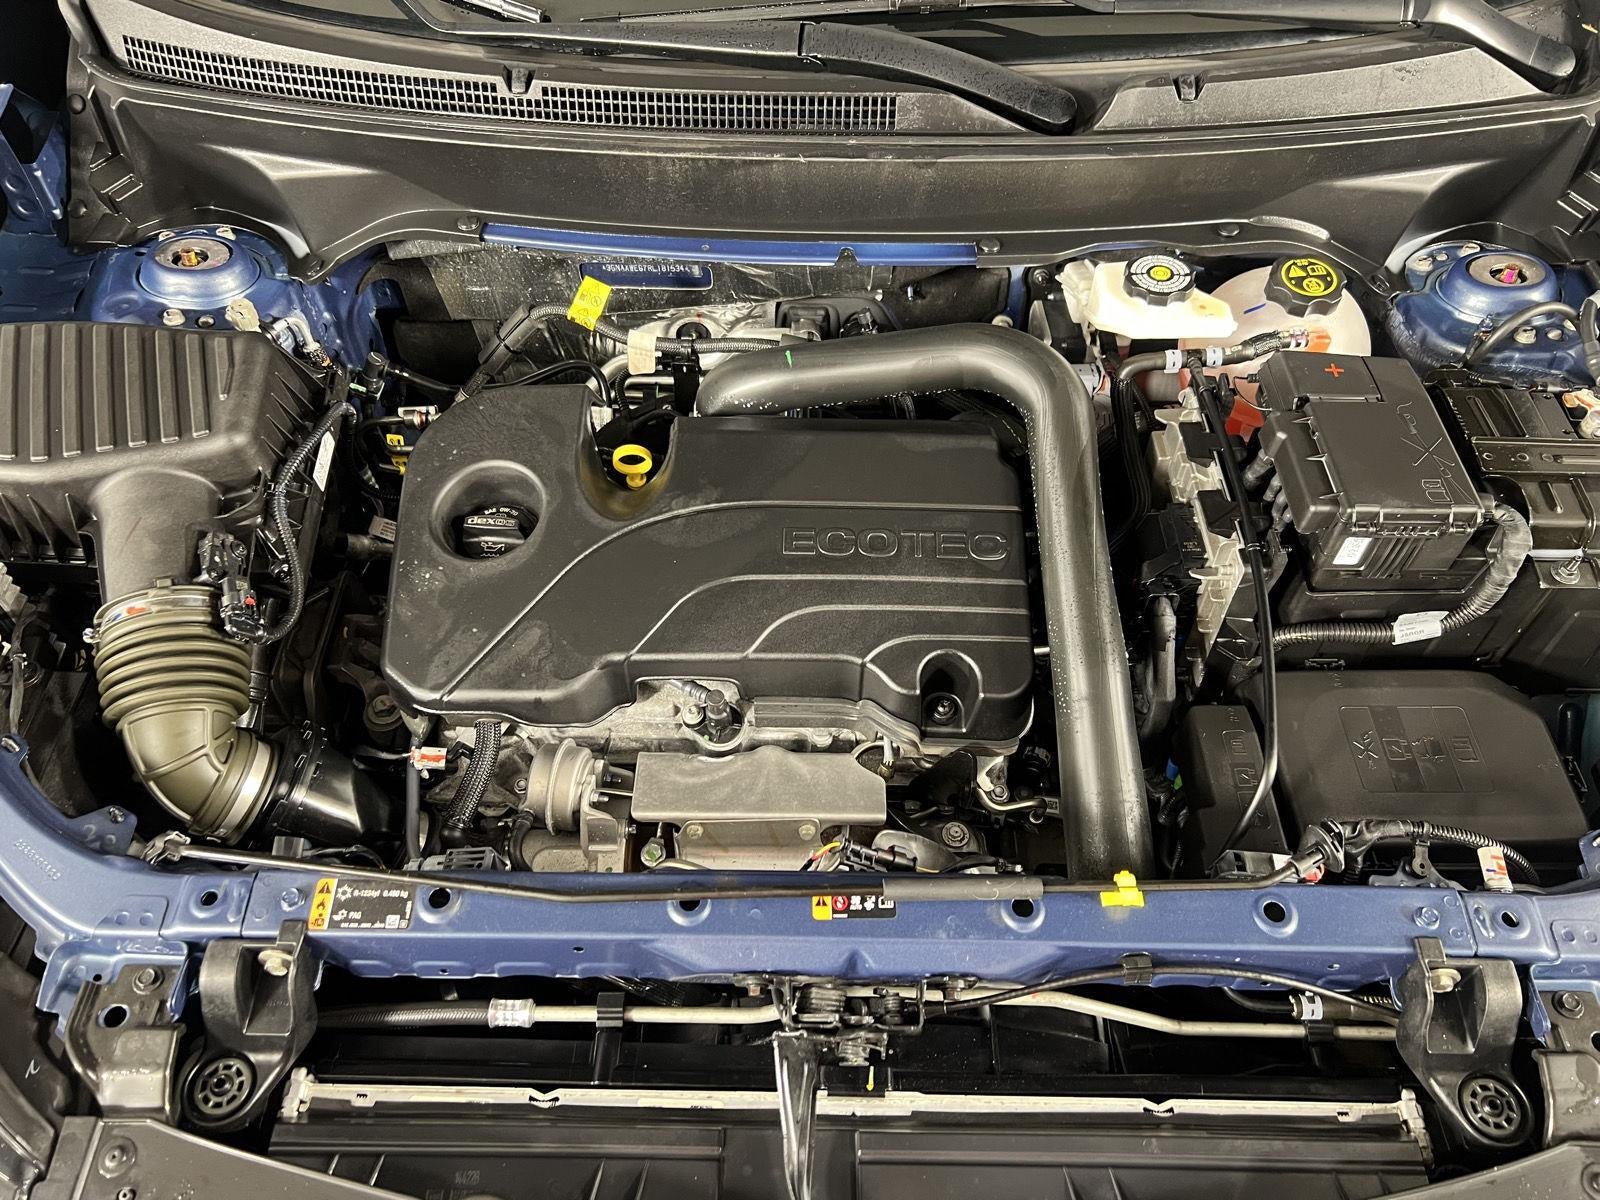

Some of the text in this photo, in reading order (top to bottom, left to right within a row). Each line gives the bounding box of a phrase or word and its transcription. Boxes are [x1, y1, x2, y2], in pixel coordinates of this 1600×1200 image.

[467, 516, 516, 526] dexos
[782, 527, 1008, 561] ECOTEC
[348, 911, 362, 920] PAG
